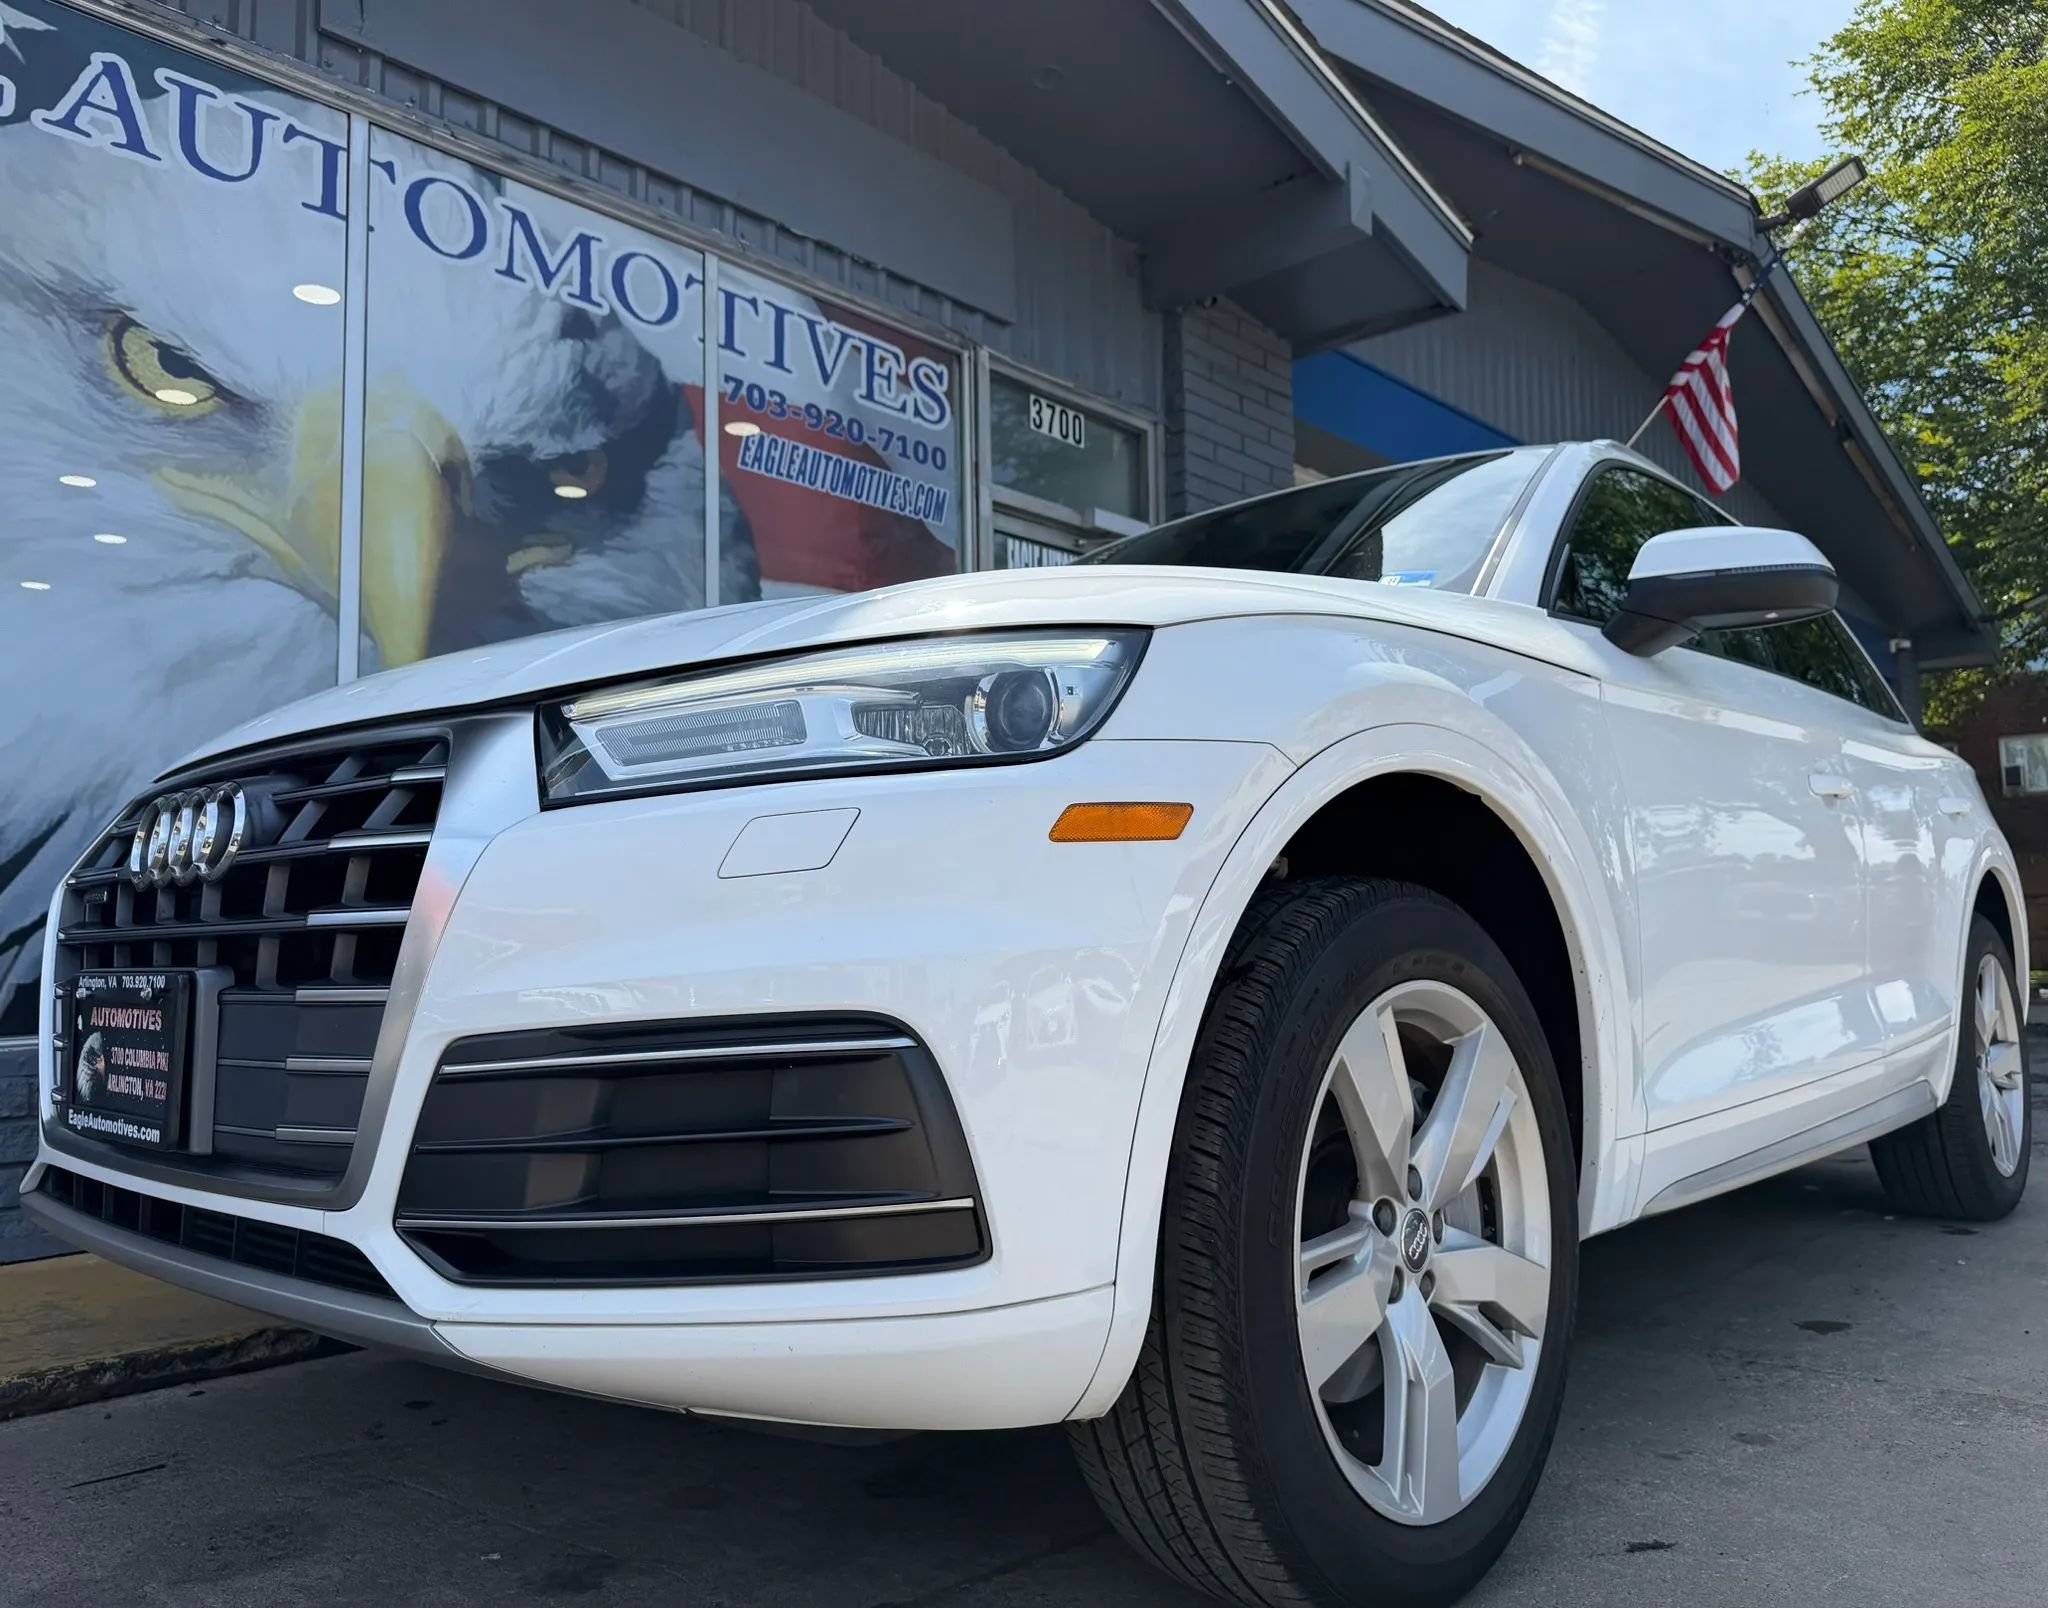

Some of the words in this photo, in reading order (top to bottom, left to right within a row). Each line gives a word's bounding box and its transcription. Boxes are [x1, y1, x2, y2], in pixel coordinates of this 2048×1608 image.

[38, 57, 950, 427] AUTOMOTIVES
[725, 375, 947, 471] 703-920-7100
[1032, 398, 1082, 445] 3700
[739, 436, 948, 525] EAGLEAUTOMOTIVES.COM
[78, 976, 106, 990] Arlington,
[108, 976, 117, 988] VA
[122, 975, 166, 989] 703.920.7100
[90, 1007, 162, 1031] AUTOMOTIVES
[125, 1048, 156, 1070] COLUMBIA
[68, 1108, 160, 1143] EagleAutomotives.com
